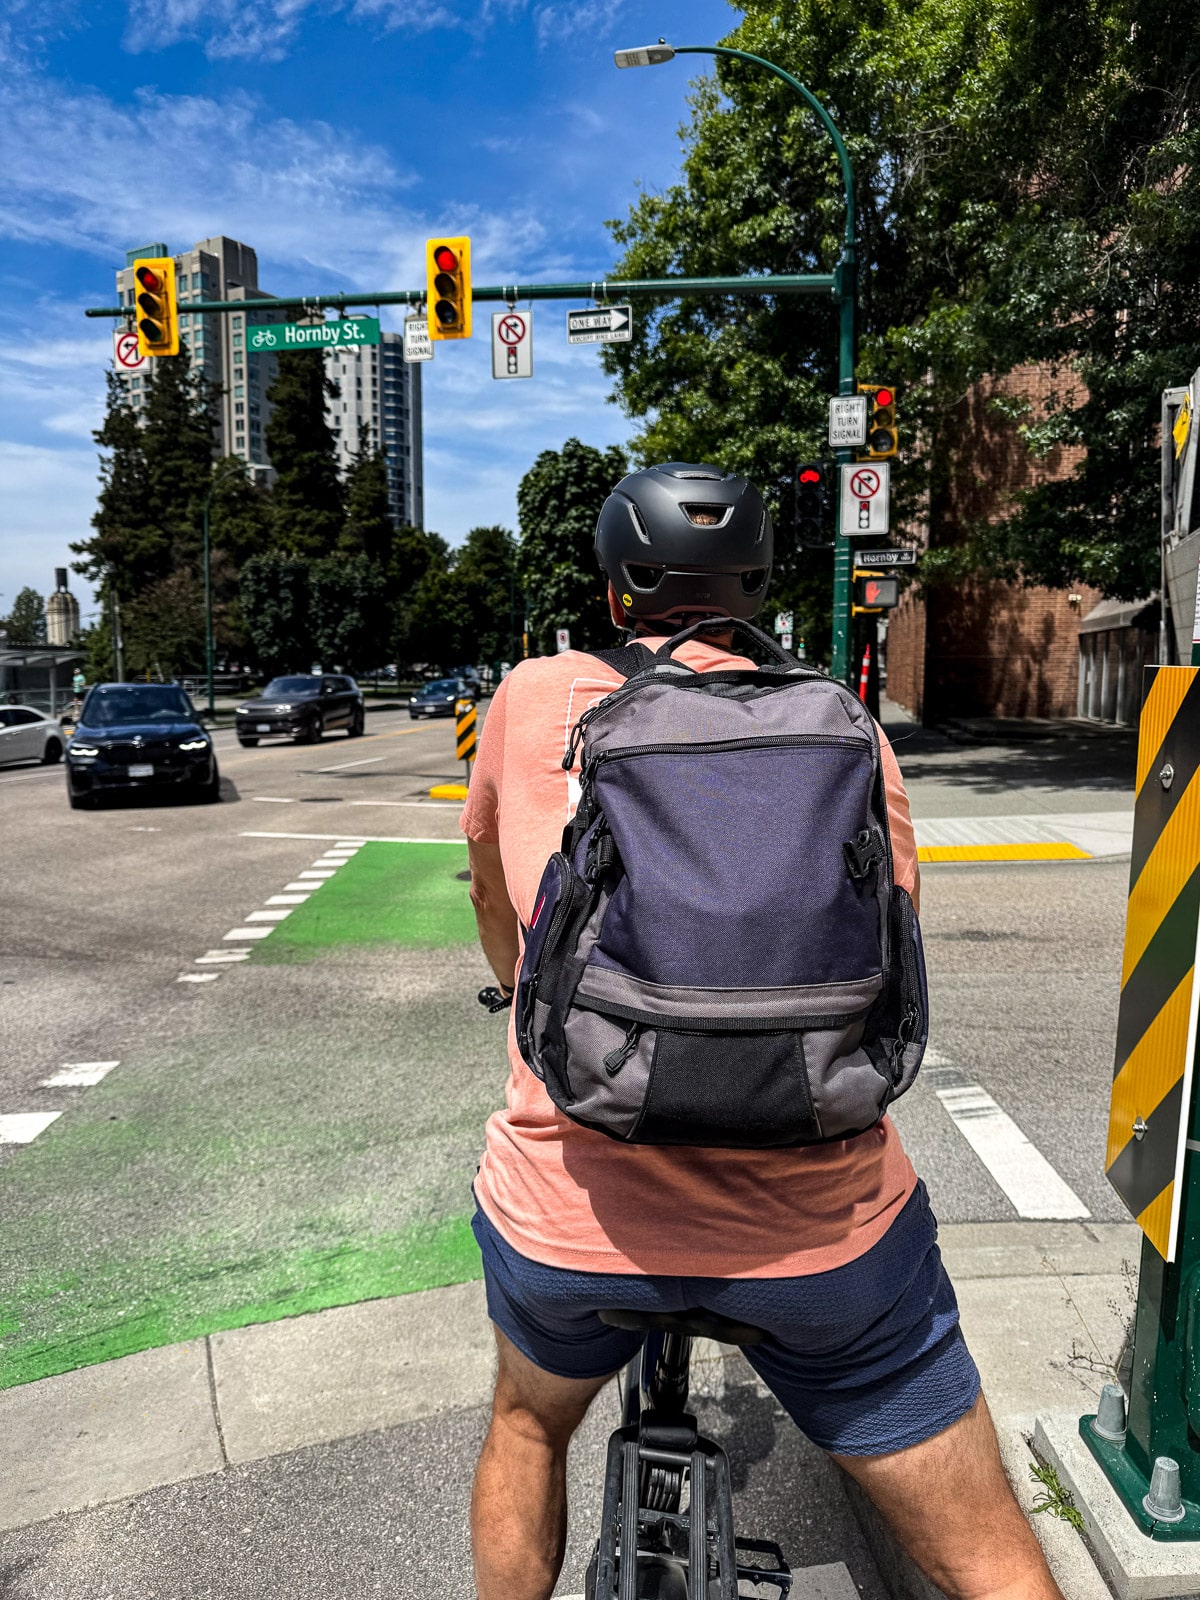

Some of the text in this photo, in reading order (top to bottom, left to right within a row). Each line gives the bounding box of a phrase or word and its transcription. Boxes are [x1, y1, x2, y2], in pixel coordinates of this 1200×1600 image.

[572, 316, 612, 329] ONE WAY
[285, 323, 366, 345] Hornby St.
[835, 403, 861, 414] RIGHT
[837, 416, 858, 427] TURN
[832, 429, 862, 440] SIGNAL
[863, 553, 899, 563] Hornby
